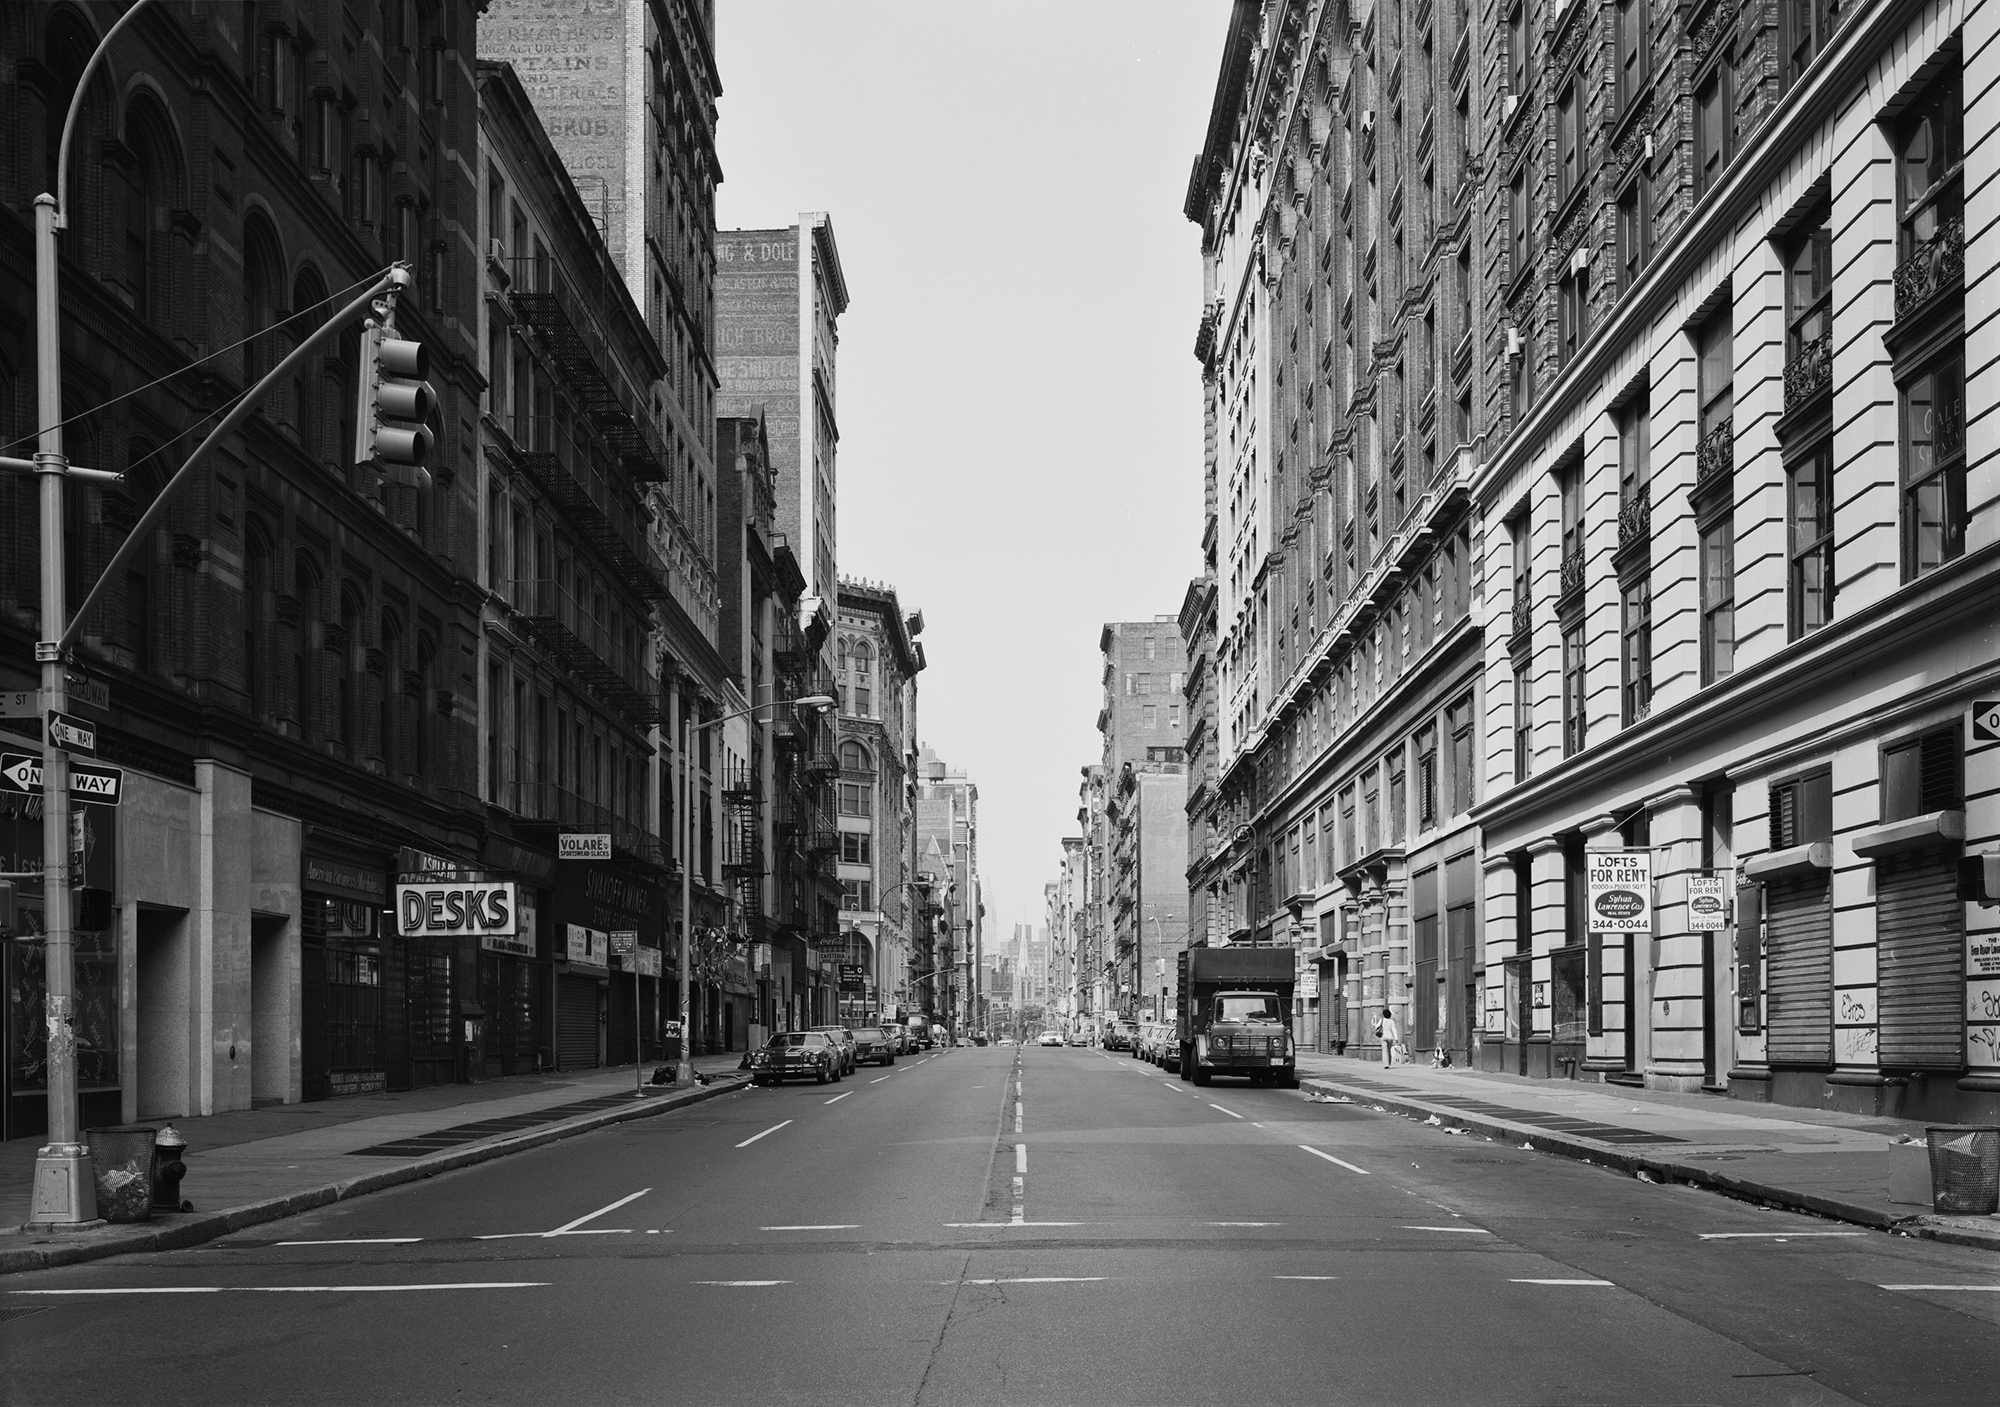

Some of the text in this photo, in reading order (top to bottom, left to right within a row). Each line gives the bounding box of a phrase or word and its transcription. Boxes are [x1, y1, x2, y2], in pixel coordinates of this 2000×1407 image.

[744, 243, 756, 262] &
[15, 694, 27, 705] ST
[54, 722, 93, 747] ONE WAY
[17, 767, 111, 793] ON WAY
[560, 839, 603, 851] VOLARE
[1598, 857, 1638, 868] LOFTS
[1590, 868, 1647, 882] FOR RENT
[1693, 879, 1719, 887] LOFTS
[1608, 894, 1633, 904] Sylvan
[402, 889, 509, 930] DESKS
[1597, 902, 1630, 911] Lawrence
[592, 906, 611, 928] STORE
[1592, 919, 1649, 929] 344-0044
[1691, 922, 1723, 930] 344-0044
